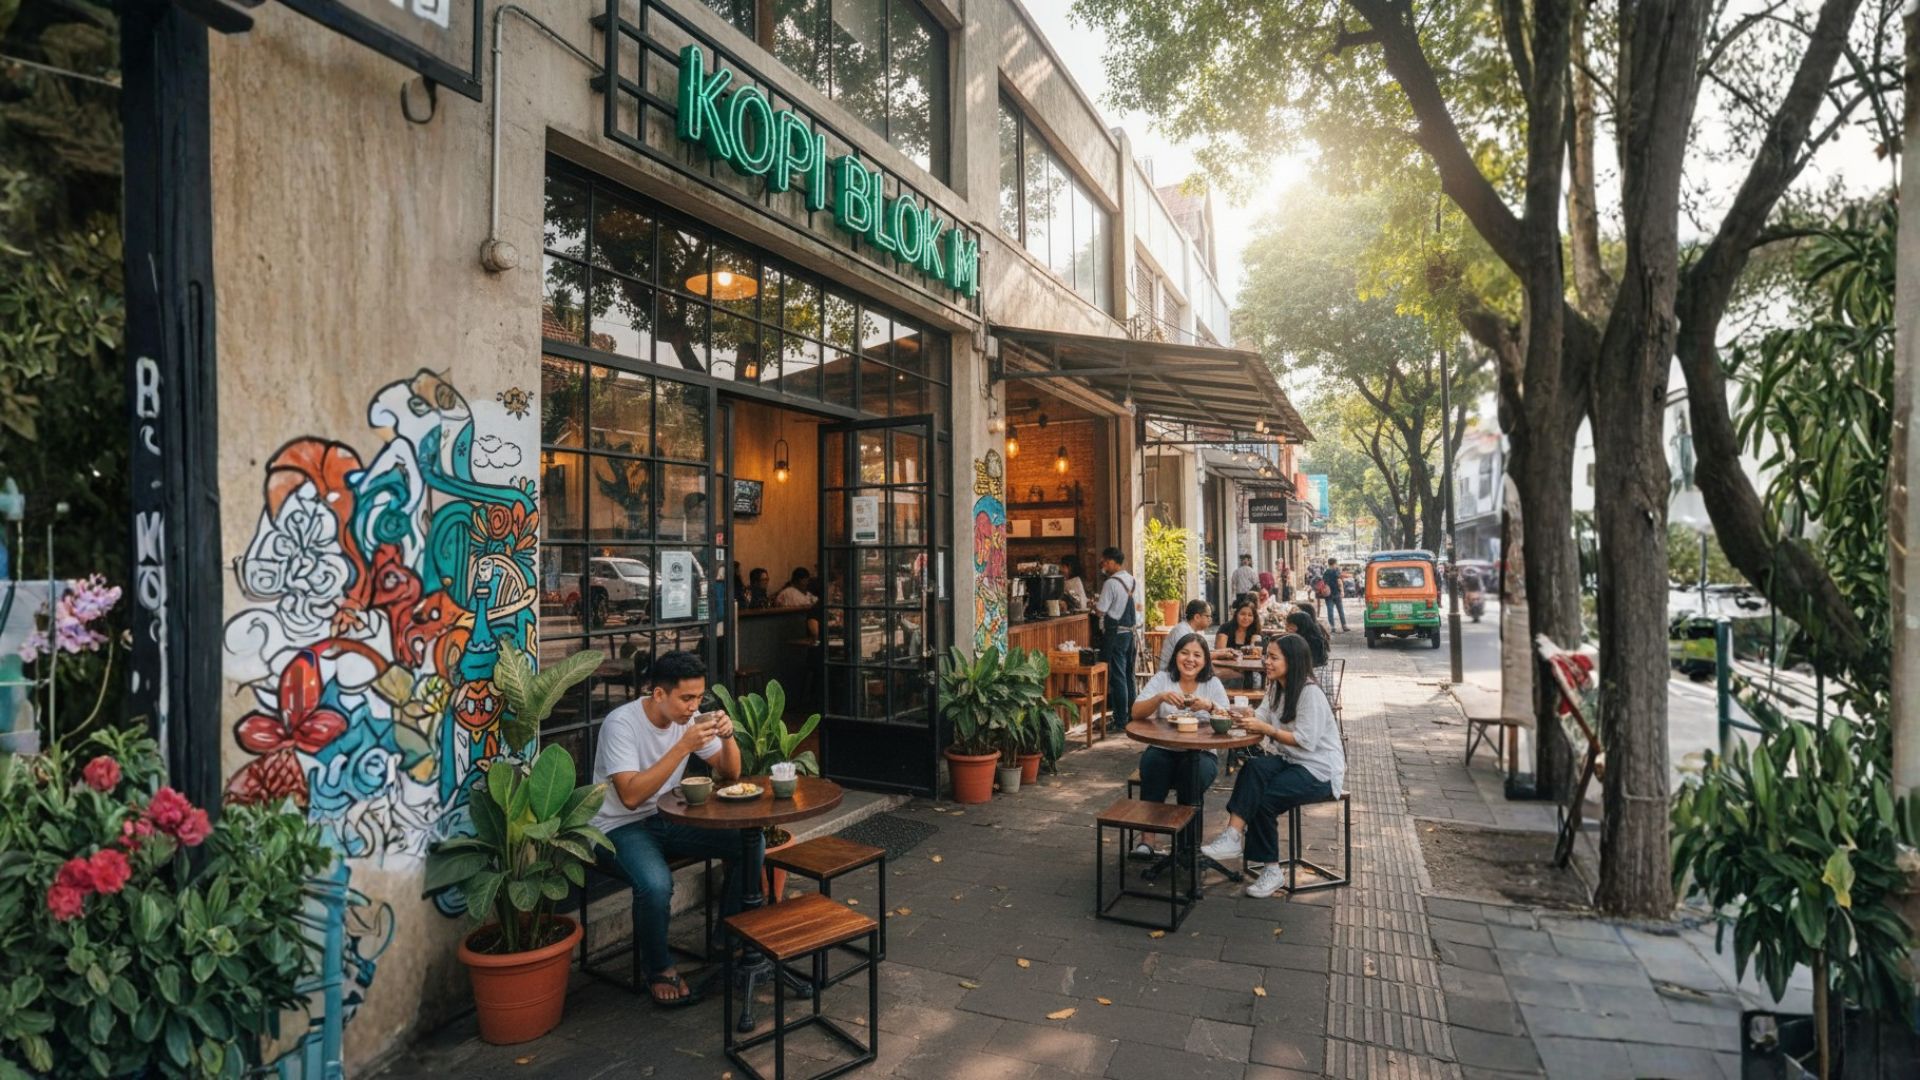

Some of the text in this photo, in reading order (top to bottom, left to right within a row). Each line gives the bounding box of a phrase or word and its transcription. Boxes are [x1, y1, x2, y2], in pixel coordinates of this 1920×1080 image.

[679, 45, 977, 297] KOPI BLOK M
